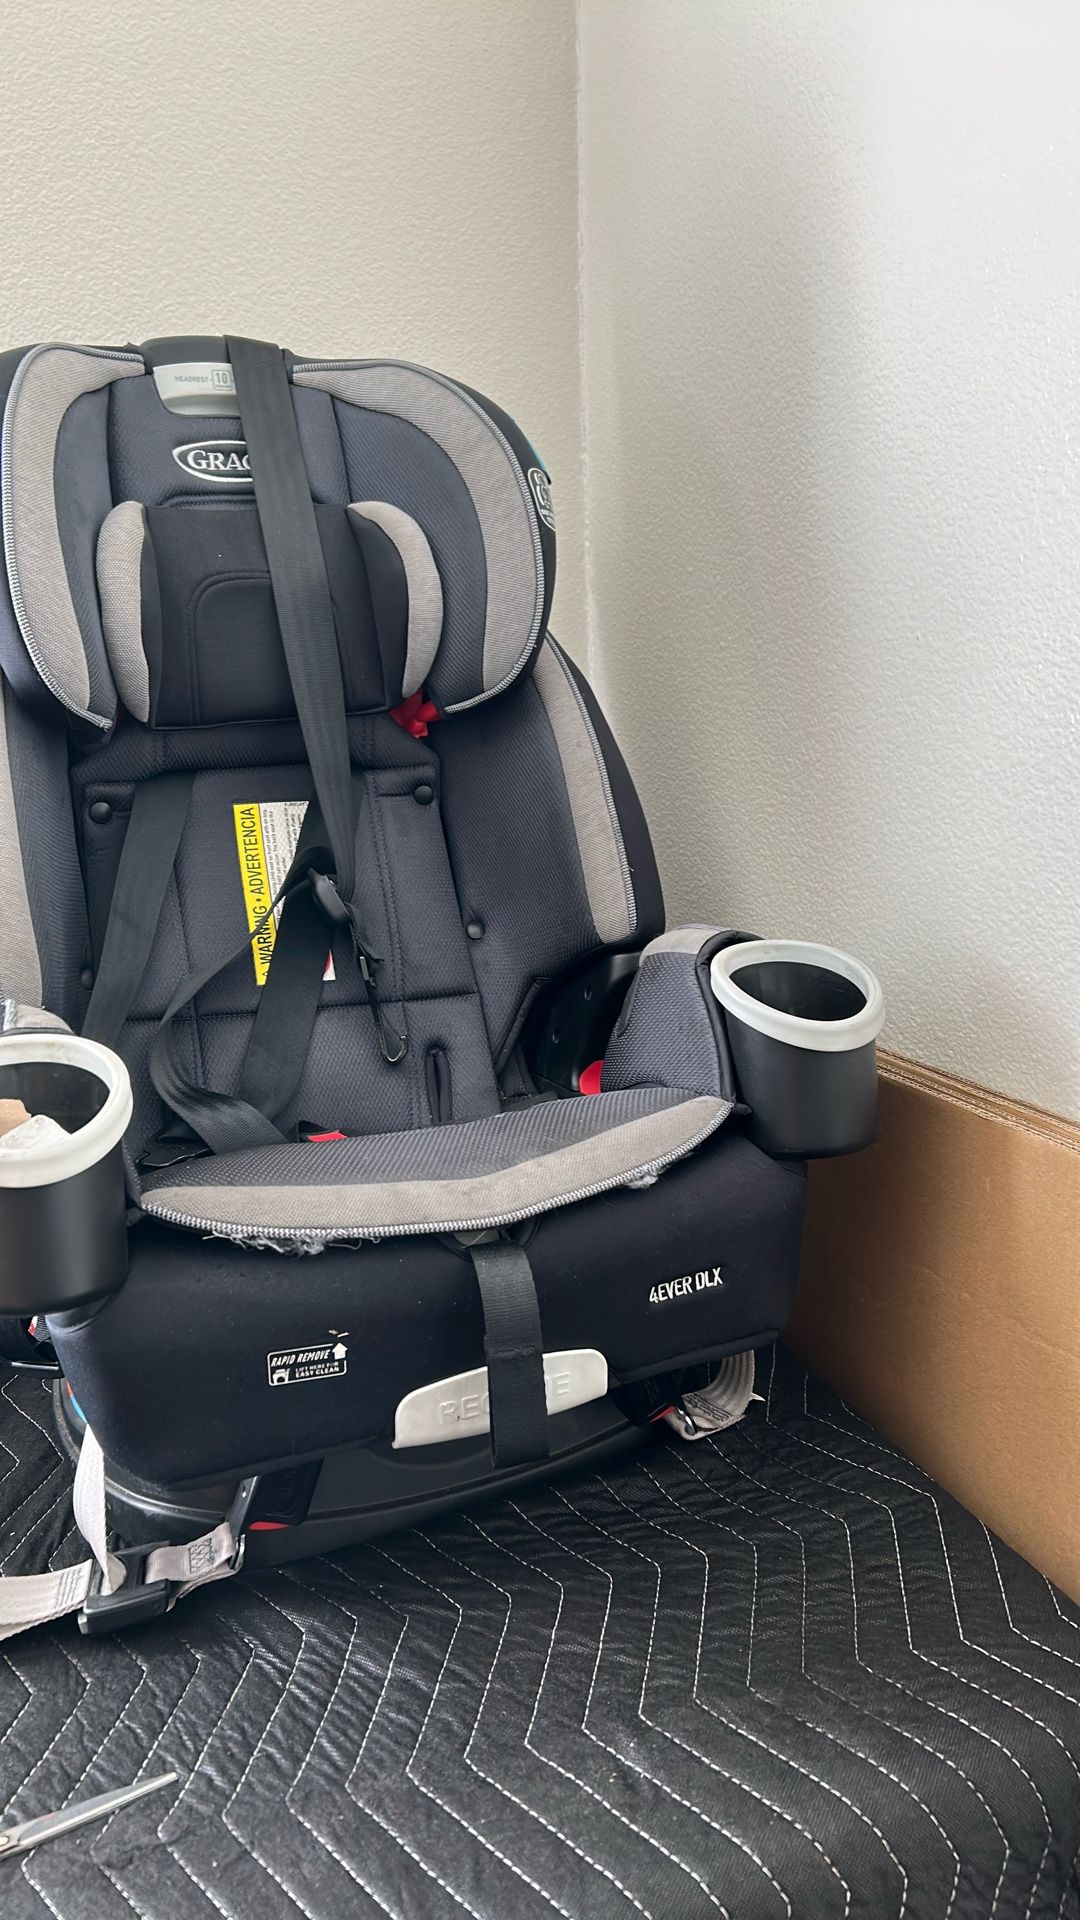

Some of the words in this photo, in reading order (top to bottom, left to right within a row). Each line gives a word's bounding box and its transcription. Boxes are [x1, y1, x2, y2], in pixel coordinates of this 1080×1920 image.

[215, 372, 228, 384] 10
[240, 807, 265, 895] ADVERTENCIA
[649, 1276, 693, 1304] 4EVER
[695, 1267, 723, 1290] DLX
[271, 1354, 296, 1367] RAPID
[297, 1349, 331, 1363] REMOVE
[295, 1371, 314, 1379] EASY
[315, 1366, 339, 1375] CLEAN
